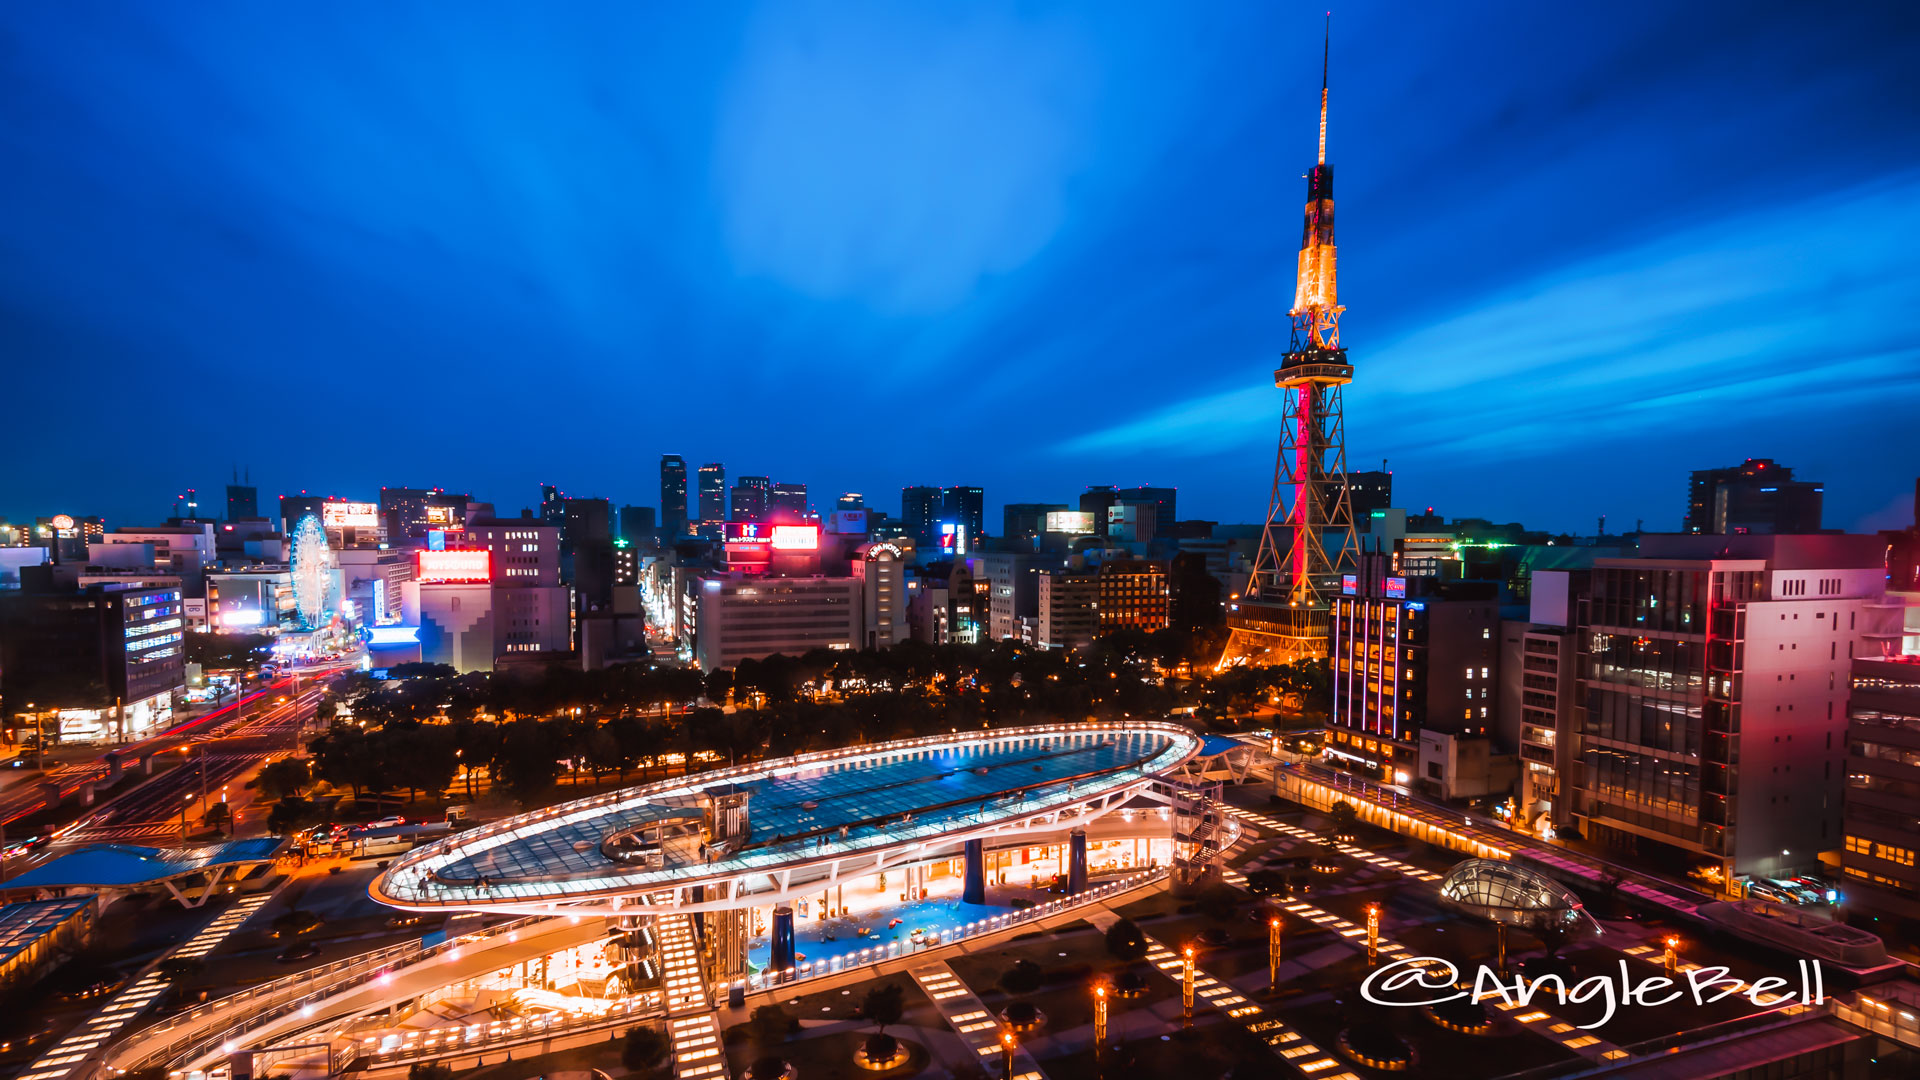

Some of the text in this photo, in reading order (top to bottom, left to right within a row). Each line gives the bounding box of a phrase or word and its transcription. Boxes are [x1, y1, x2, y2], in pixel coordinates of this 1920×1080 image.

[870, 543, 902, 558] APA HOTEL
[427, 559, 484, 570] JOYSOUND
